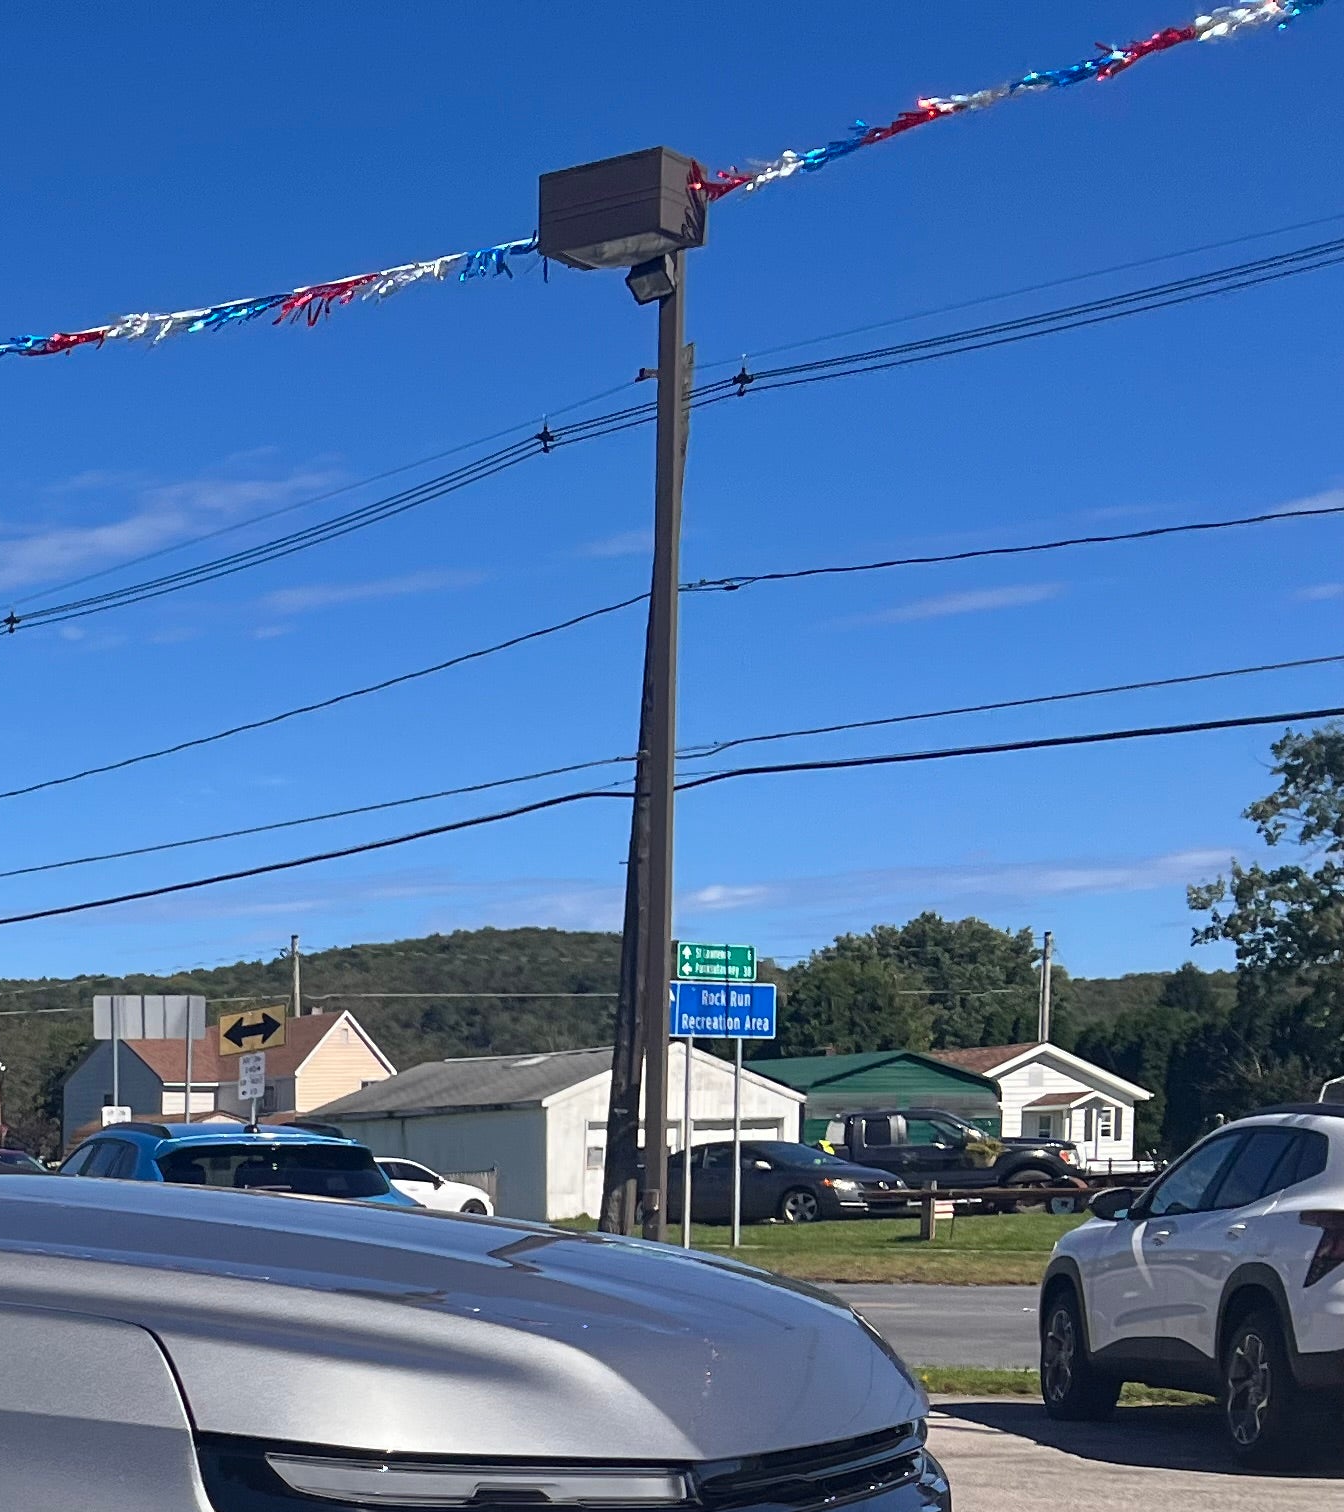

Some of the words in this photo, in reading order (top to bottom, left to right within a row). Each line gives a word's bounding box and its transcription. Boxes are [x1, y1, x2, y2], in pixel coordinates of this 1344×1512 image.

[702, 990, 726, 1006] Rock
[730, 991, 751, 1007] Run
[681, 1013, 741, 1030] Recreation
[744, 1015, 770, 1031] Area
